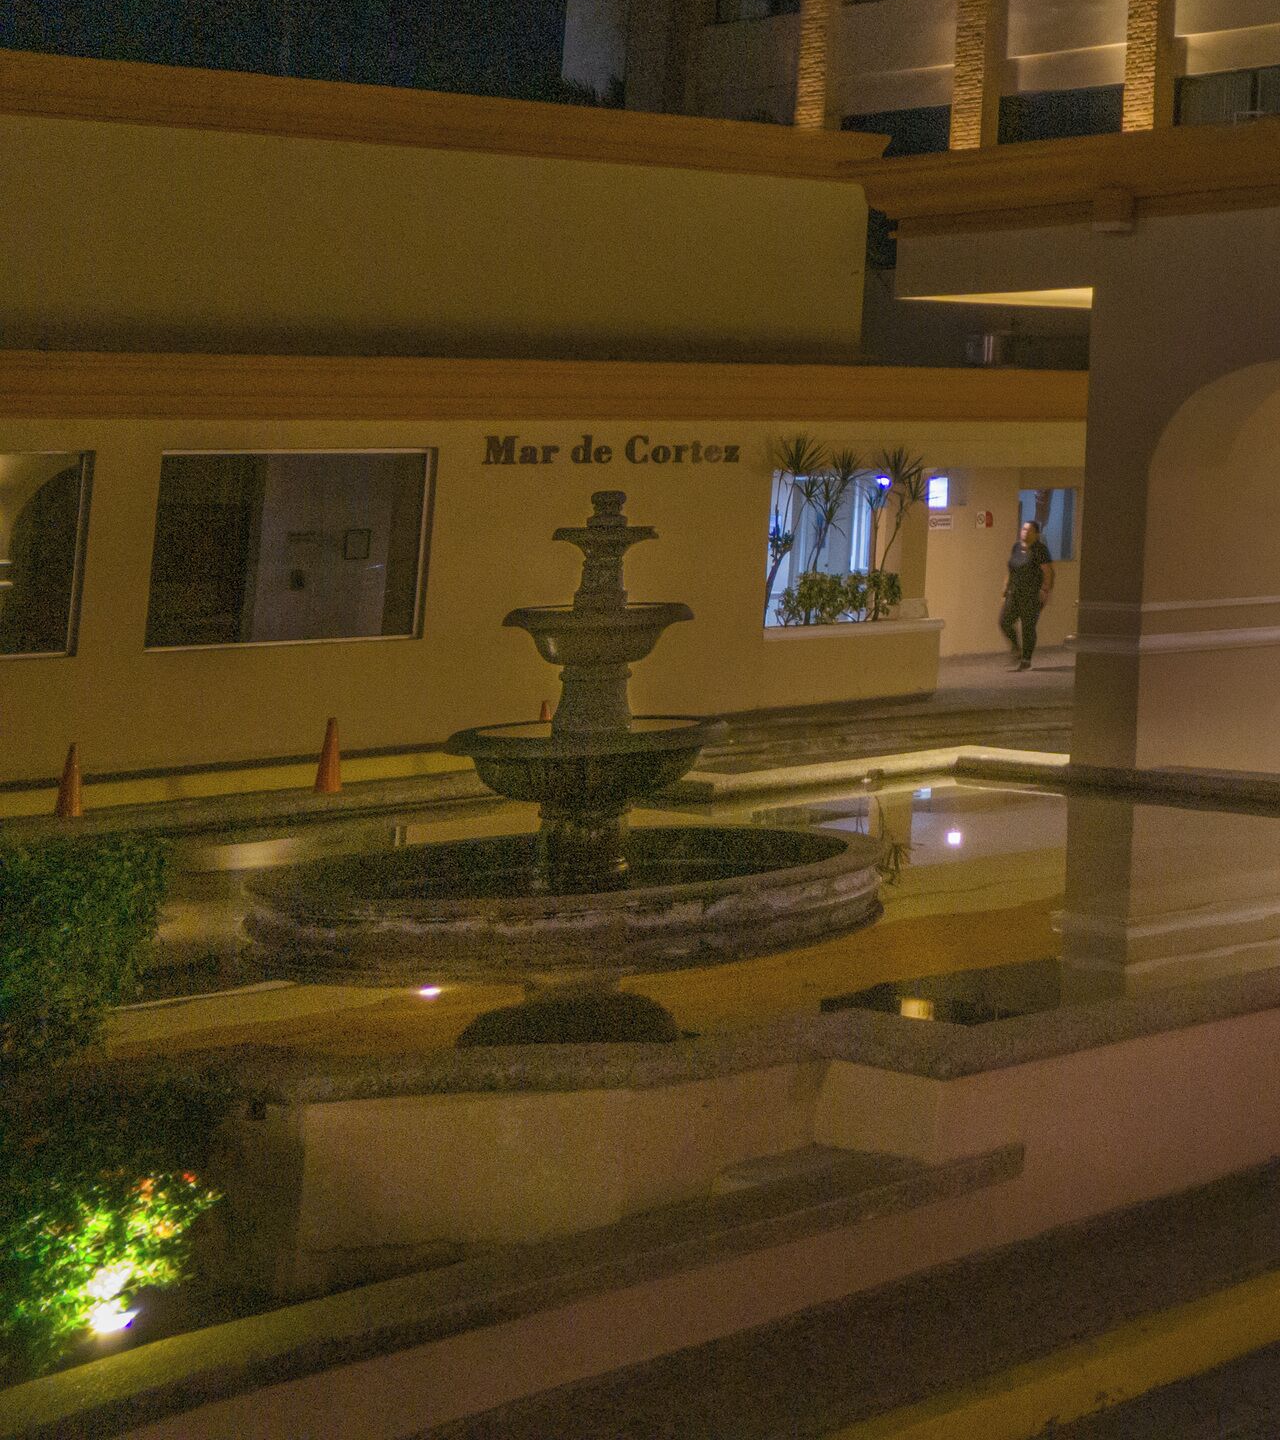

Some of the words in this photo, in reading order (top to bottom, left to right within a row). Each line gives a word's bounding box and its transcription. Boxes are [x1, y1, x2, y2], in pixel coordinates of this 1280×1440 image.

[482, 435, 560, 465] Mar
[571, 434, 612, 464] de
[625, 434, 741, 464] Cortez
